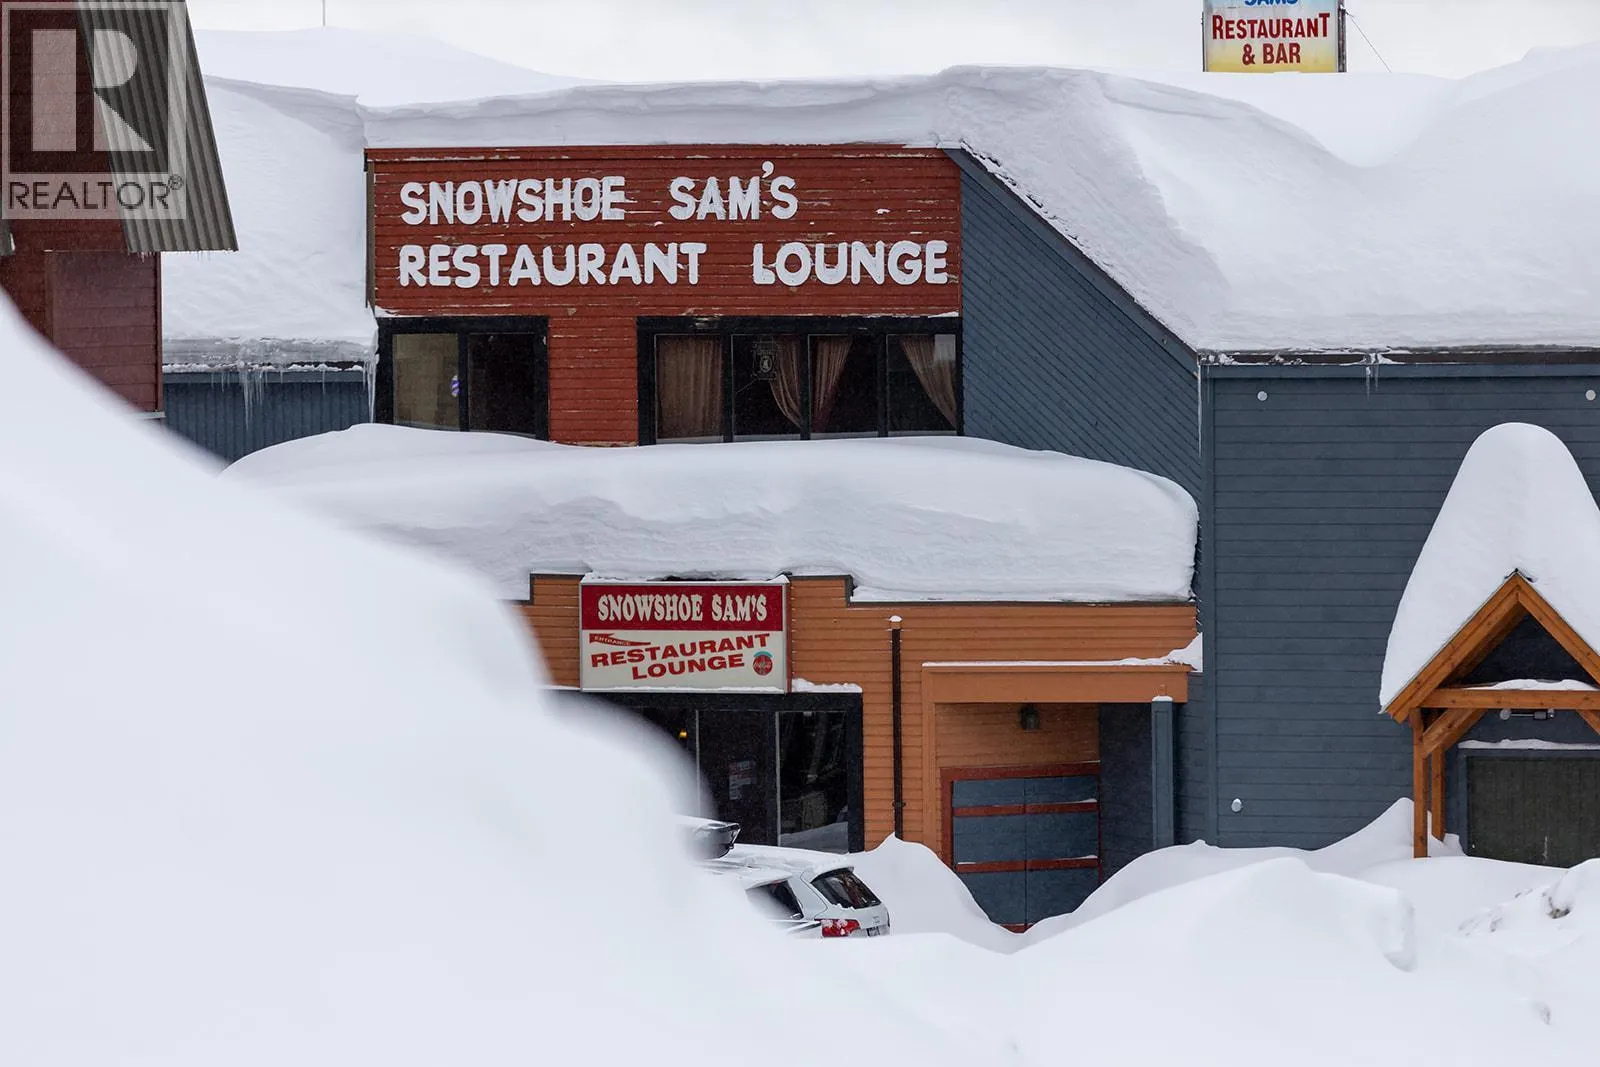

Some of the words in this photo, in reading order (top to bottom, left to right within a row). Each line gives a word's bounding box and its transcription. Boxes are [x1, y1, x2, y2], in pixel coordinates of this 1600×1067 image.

[1212, 13, 1330, 39] RESTAURANT
[1242, 44, 1255, 65] &
[1262, 43, 1301, 64] BAR
[400, 176, 626, 225] SNOWSHOE
[668, 161, 798, 221] SAM'S
[399, 242, 707, 287] RESTAURANT
[752, 240, 949, 287] LOUNGE
[598, 593, 703, 622] SNOWSHOE
[711, 593, 767, 622] SAM'S
[591, 633, 770, 668] RESTAURANT
[632, 653, 745, 680] LOUNGE
